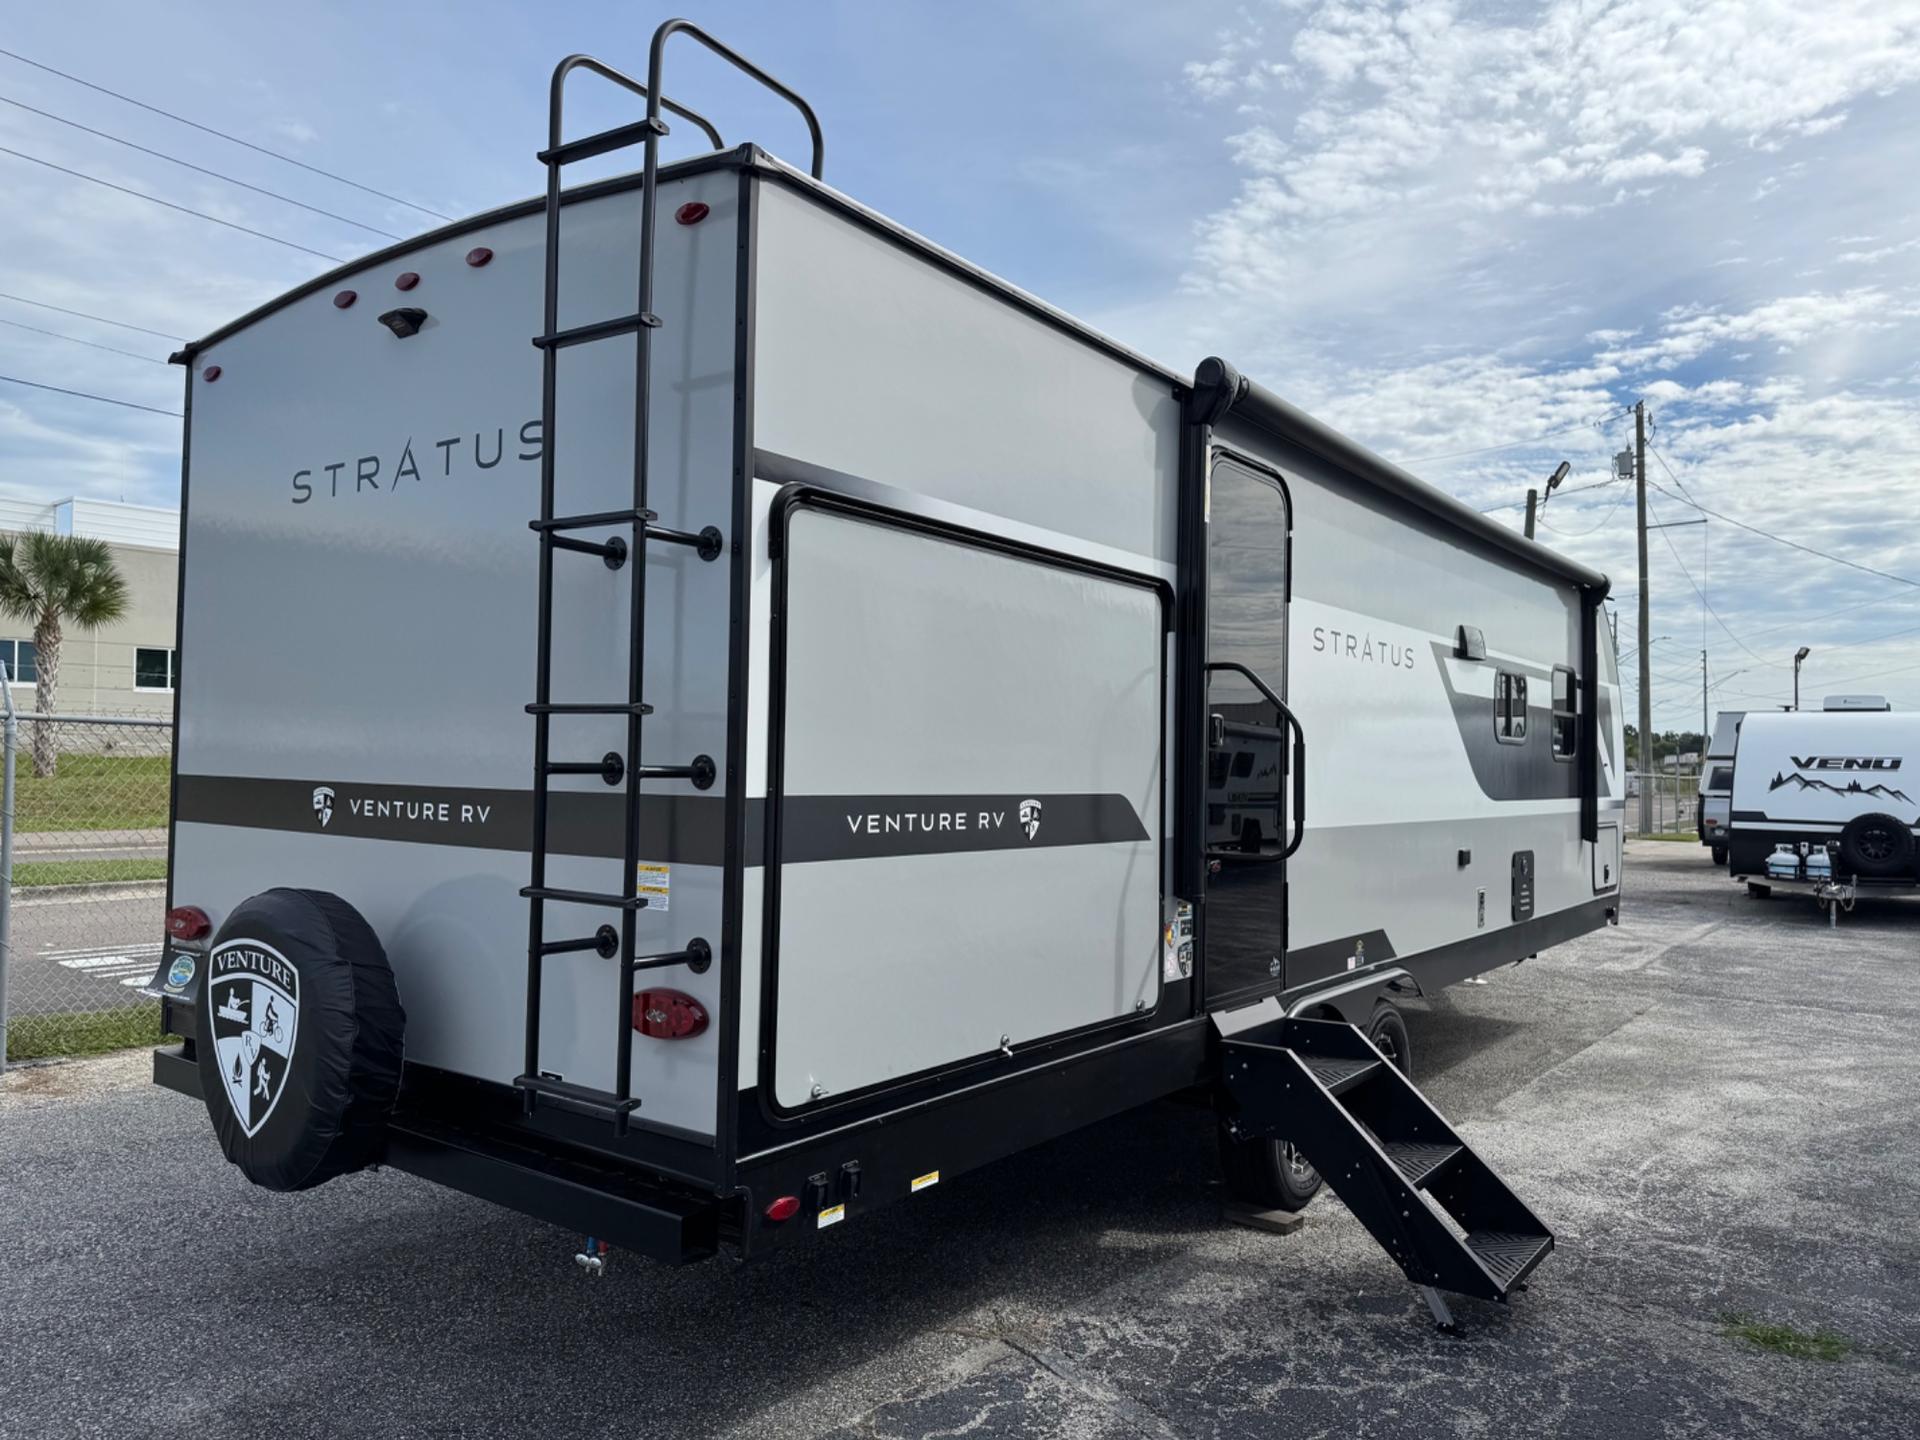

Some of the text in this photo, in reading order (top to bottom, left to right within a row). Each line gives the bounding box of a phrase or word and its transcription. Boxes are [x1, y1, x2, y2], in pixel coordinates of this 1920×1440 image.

[291, 420, 542, 504] STRATUS
[1313, 627, 1414, 669] STRATUS
[1790, 756, 1903, 771] VENU
[350, 799, 491, 823] VENTURE RV
[847, 812, 1005, 833] VENTURE RV
[217, 950, 291, 990] VENTURE
